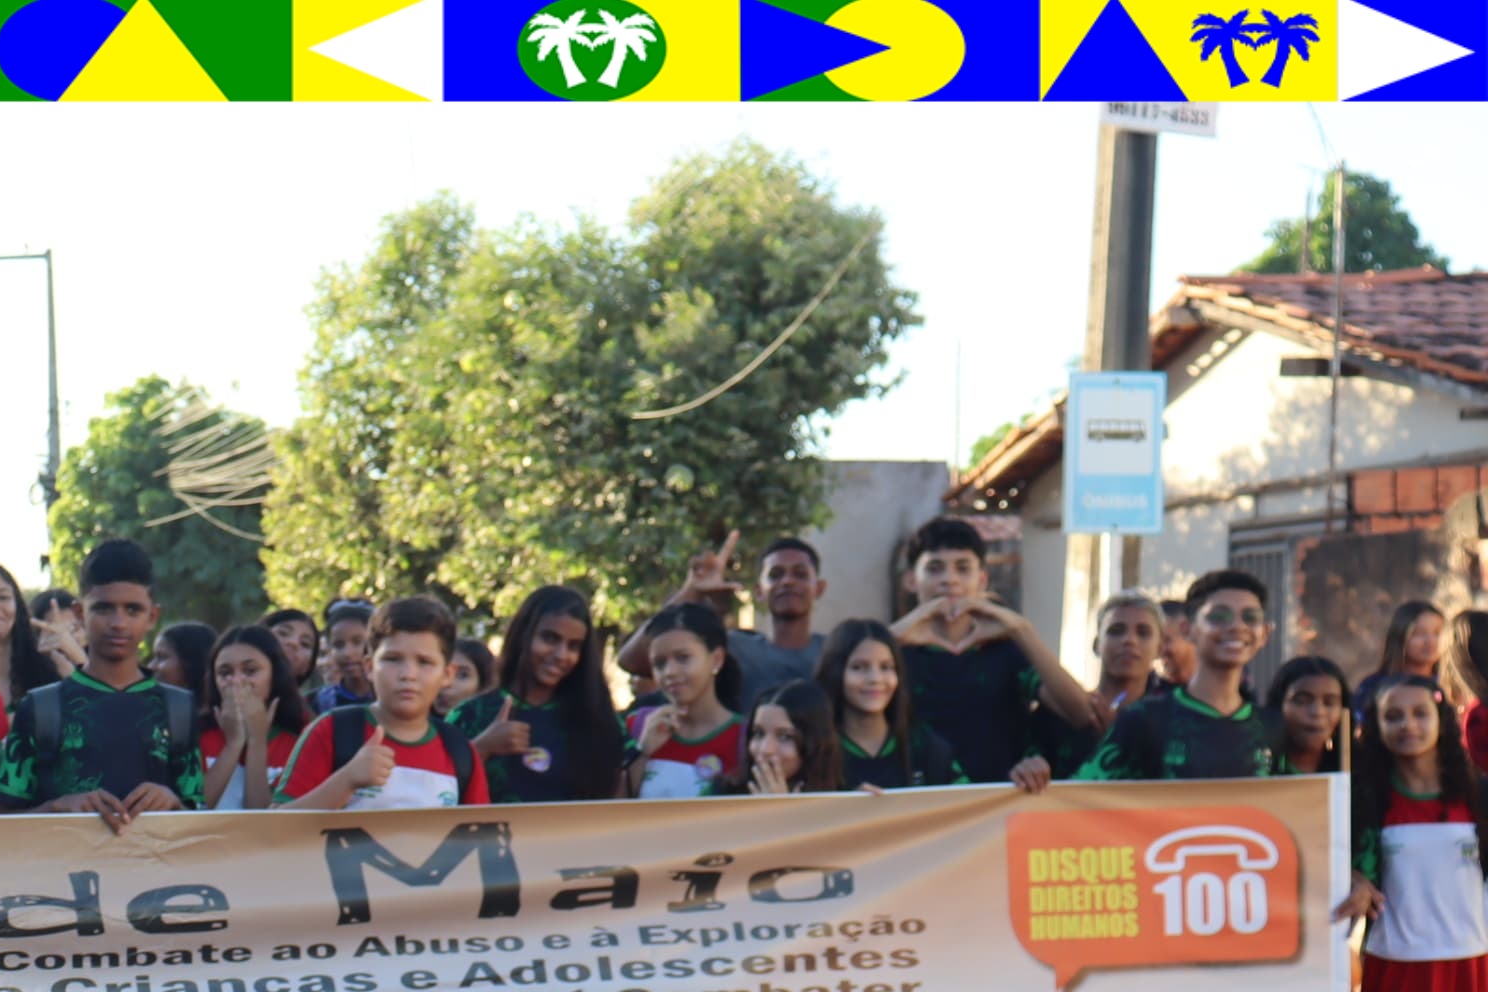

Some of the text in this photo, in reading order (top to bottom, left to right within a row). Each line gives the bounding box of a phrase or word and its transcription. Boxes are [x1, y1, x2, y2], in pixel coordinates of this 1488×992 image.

[320, 821, 855, 926] Maio
[1028, 846, 1136, 884] DISQUE
[1029, 883, 1139, 913] DIREITOS
[1152, 871, 1269, 936] 100
[271, 941, 338, 962] ao
[353, 935, 525, 959] Abuso
[542, 933, 572, 950] e
[590, 926, 620, 948] à
[637, 914, 927, 948] Exploração
[1029, 911, 1139, 940] HUMANOS
[400, 968, 438, 990] e
[459, 945, 921, 988] Adolescentes
